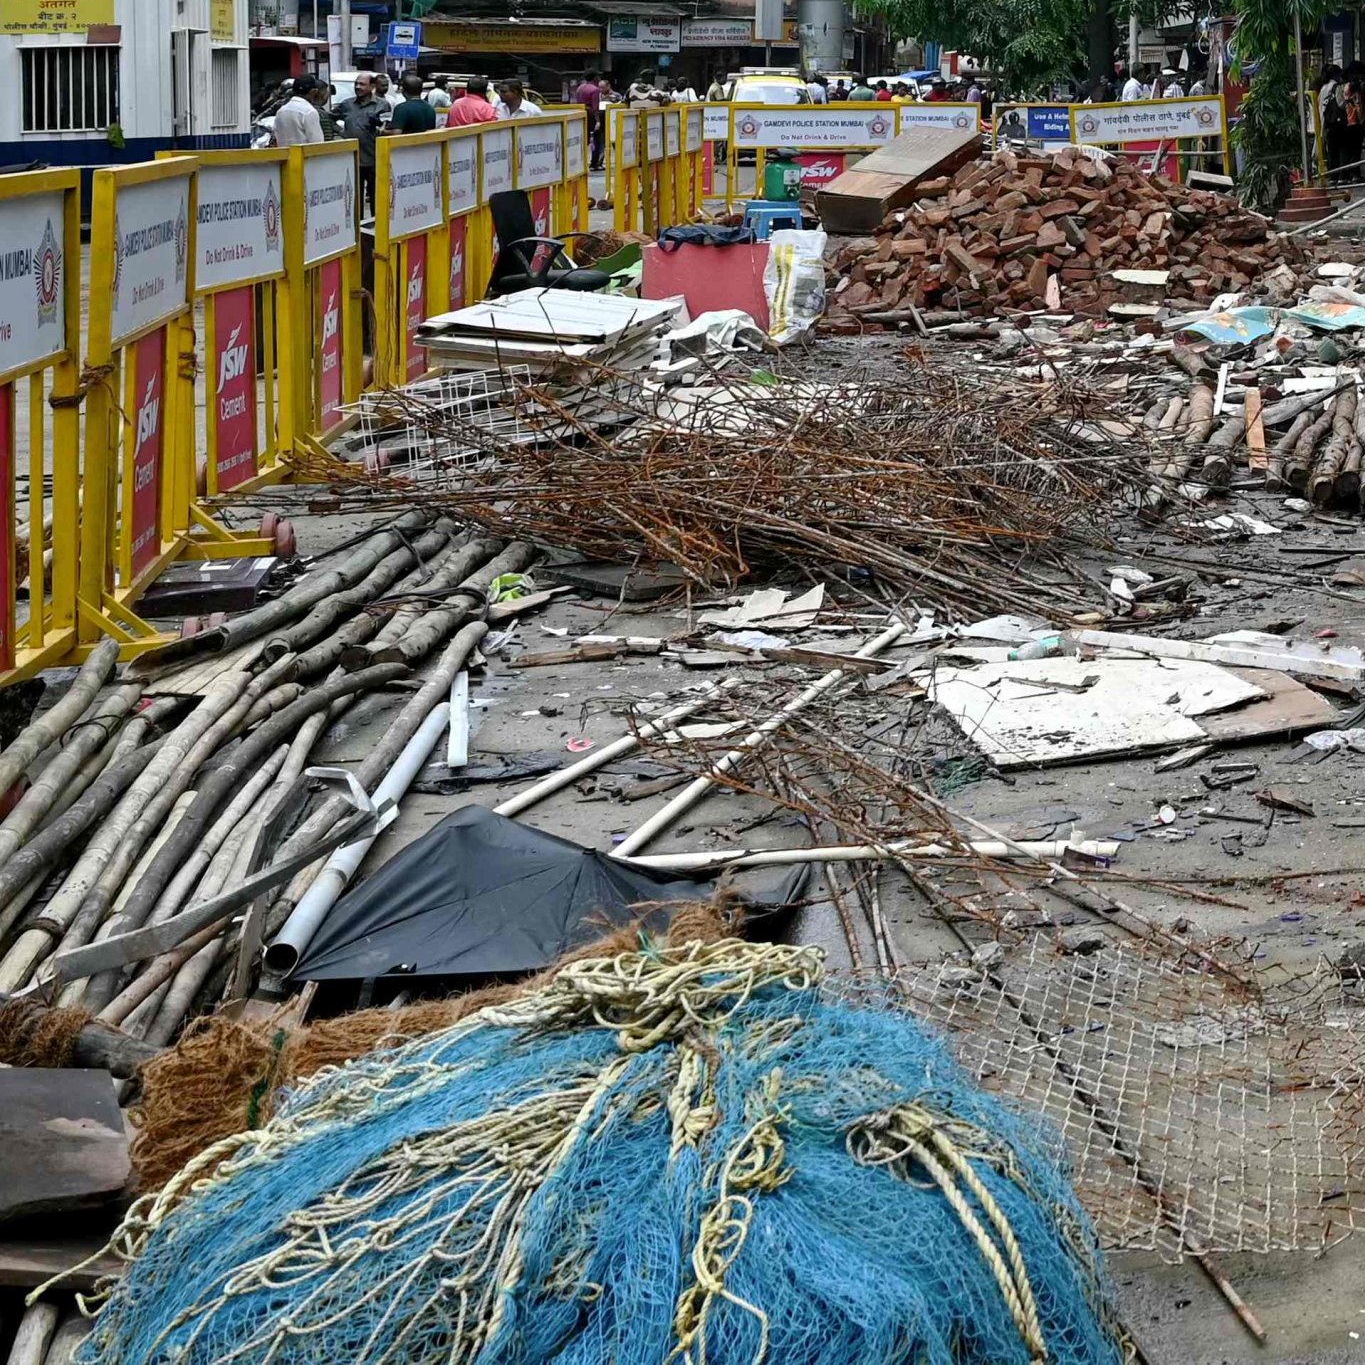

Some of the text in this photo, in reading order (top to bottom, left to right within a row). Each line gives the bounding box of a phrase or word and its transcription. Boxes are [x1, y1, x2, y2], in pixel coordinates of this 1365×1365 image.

[764, 120, 864, 128] GAMDEVI POLICE STATION MUMBAI
[1132, 113, 1156, 123] पोलीस
[1176, 109, 1191, 122] मुंबई
[214, 201, 229, 222] POLICE
[229, 200, 247, 220] STATION
[5, 248, 32, 280] MUMBAI
[206, 243, 253, 265] Do Not Drink & Drive
[407, 277, 423, 310] JSW
[321, 307, 338, 349] JSW
[216, 344, 248, 394] JSW
[220, 391, 246, 421] Cement
[134, 397, 159, 460] JSW
[135, 454, 155, 492] Cement
